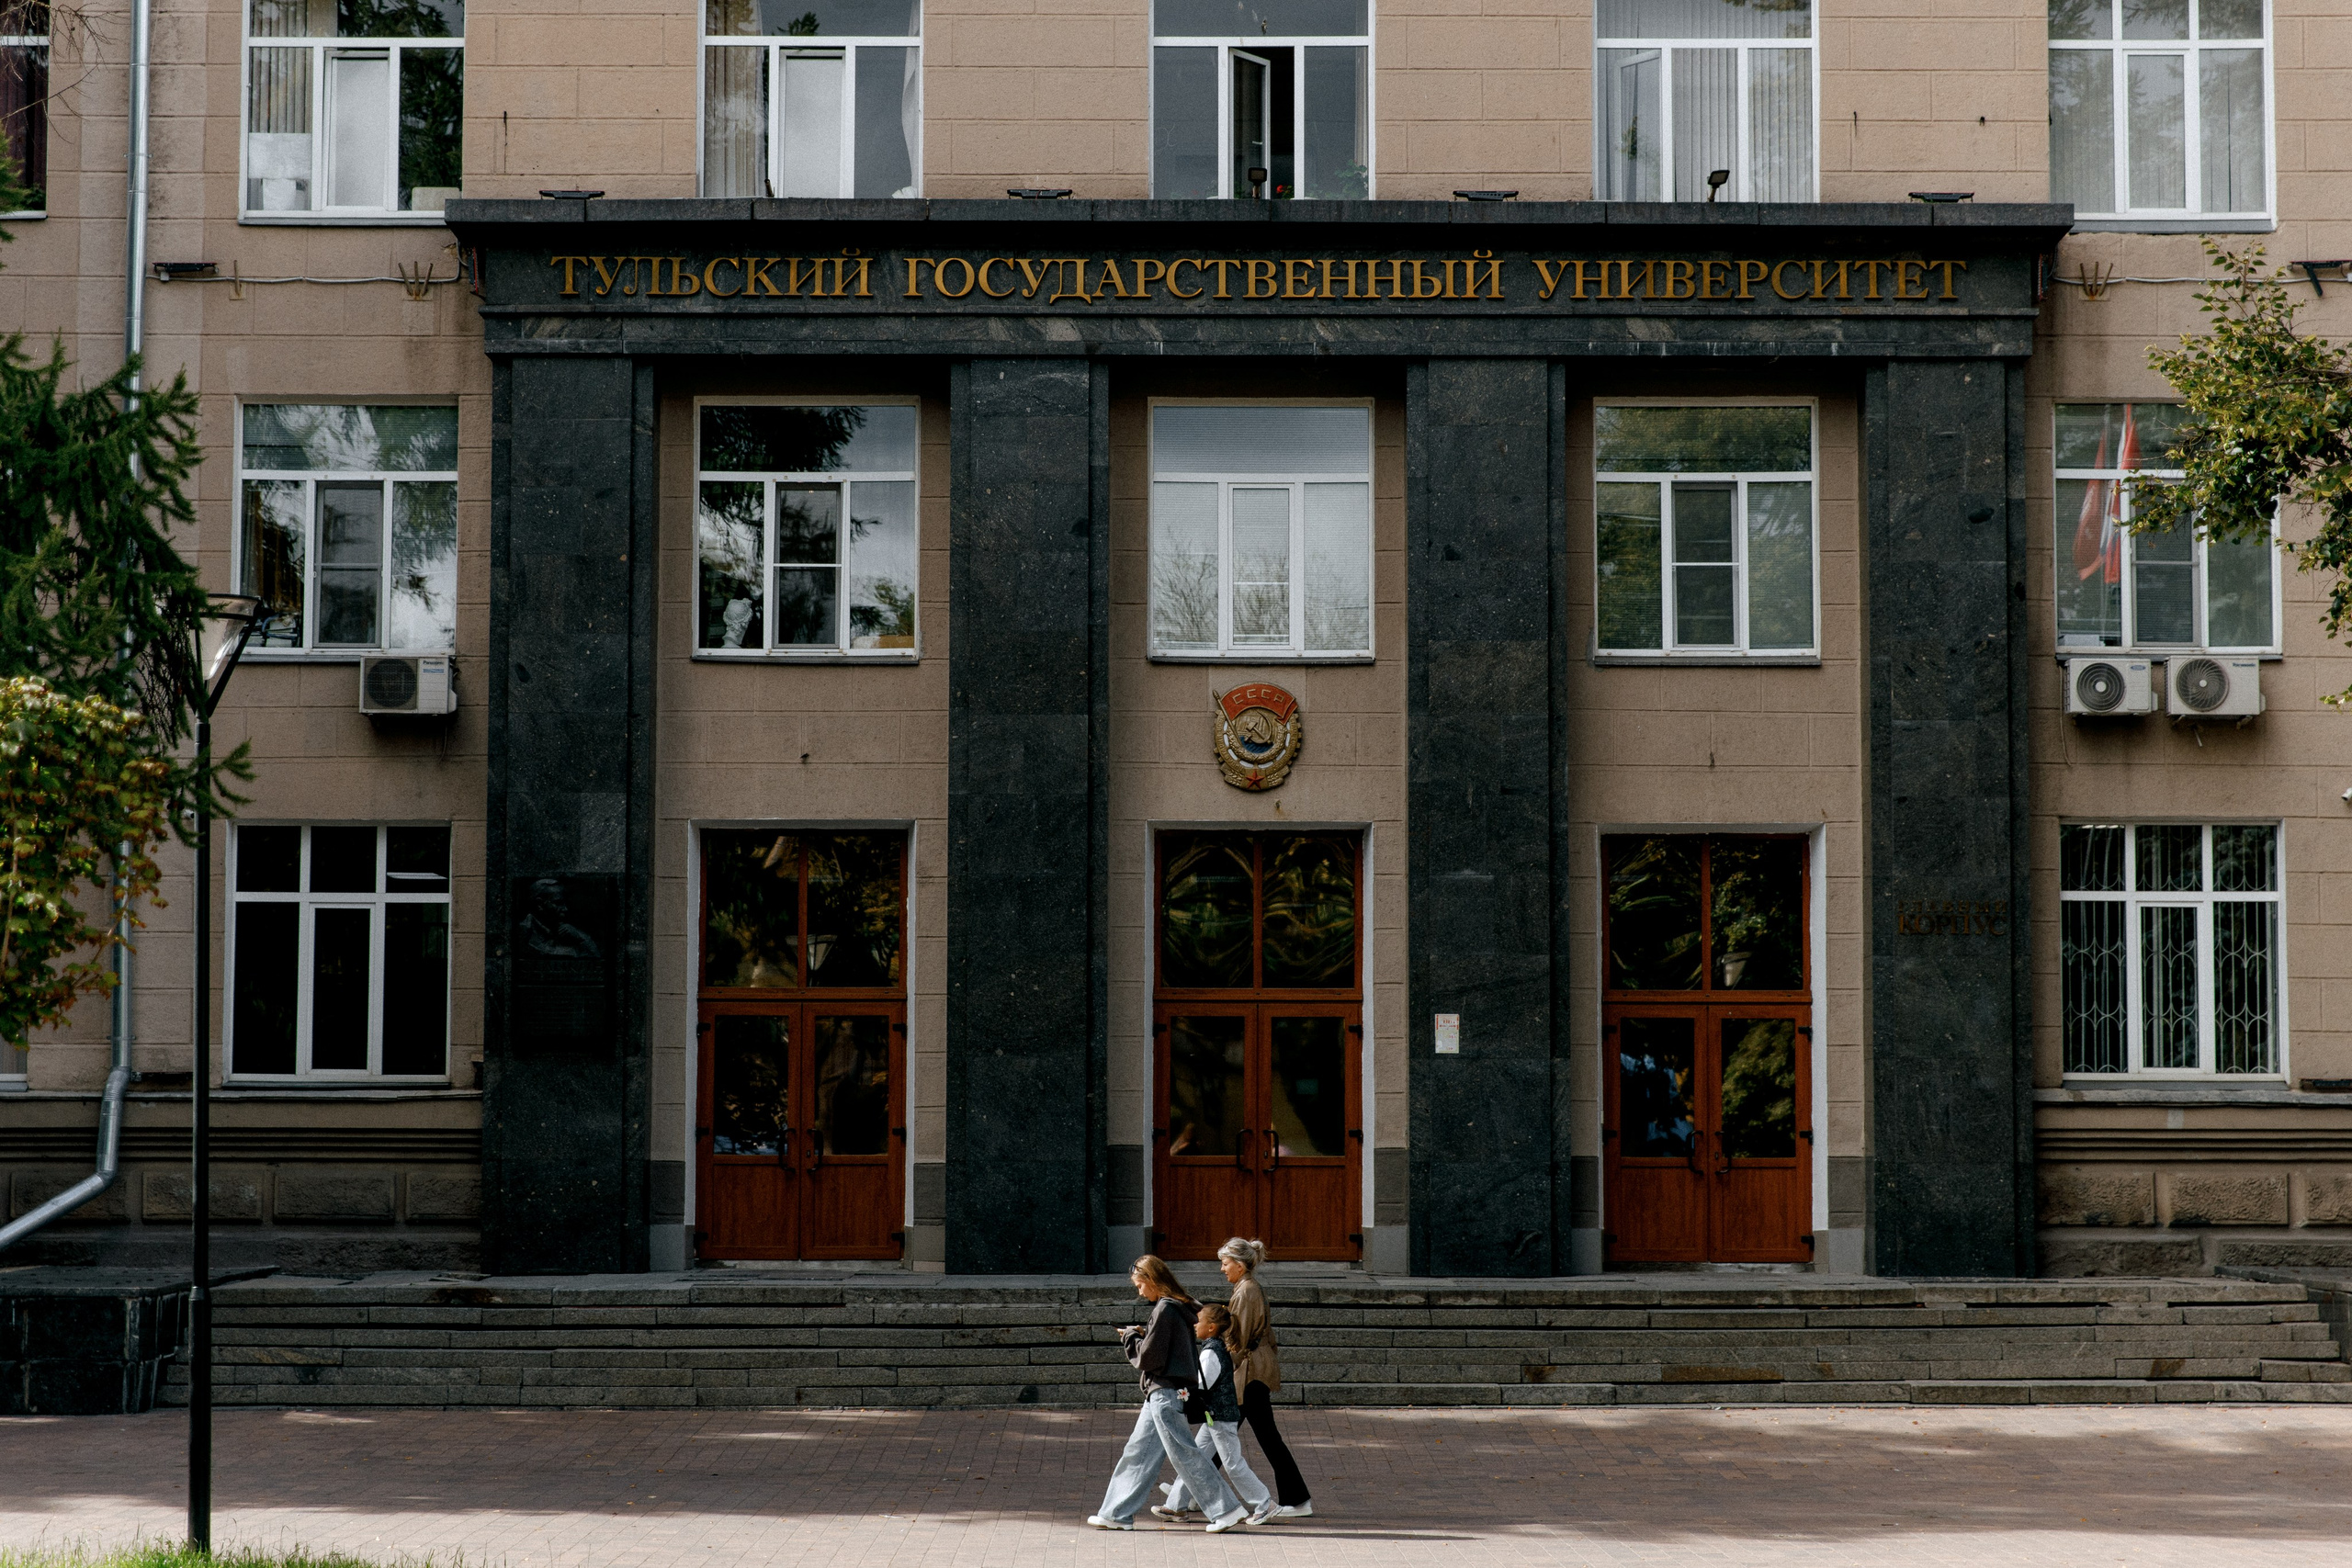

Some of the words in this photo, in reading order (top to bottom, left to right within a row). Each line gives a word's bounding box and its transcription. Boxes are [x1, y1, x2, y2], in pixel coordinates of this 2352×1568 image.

[551, 248, 874, 297] ТУЛЬСКИЙ
[902, 249, 1506, 304] ГОСУДАРСТВЕННЫЙ
[1532, 259, 1968, 299] УНИВЕРСИТЕТ
[1232, 688, 1284, 705] СССР
[1897, 913, 2007, 935] КОРПУС
